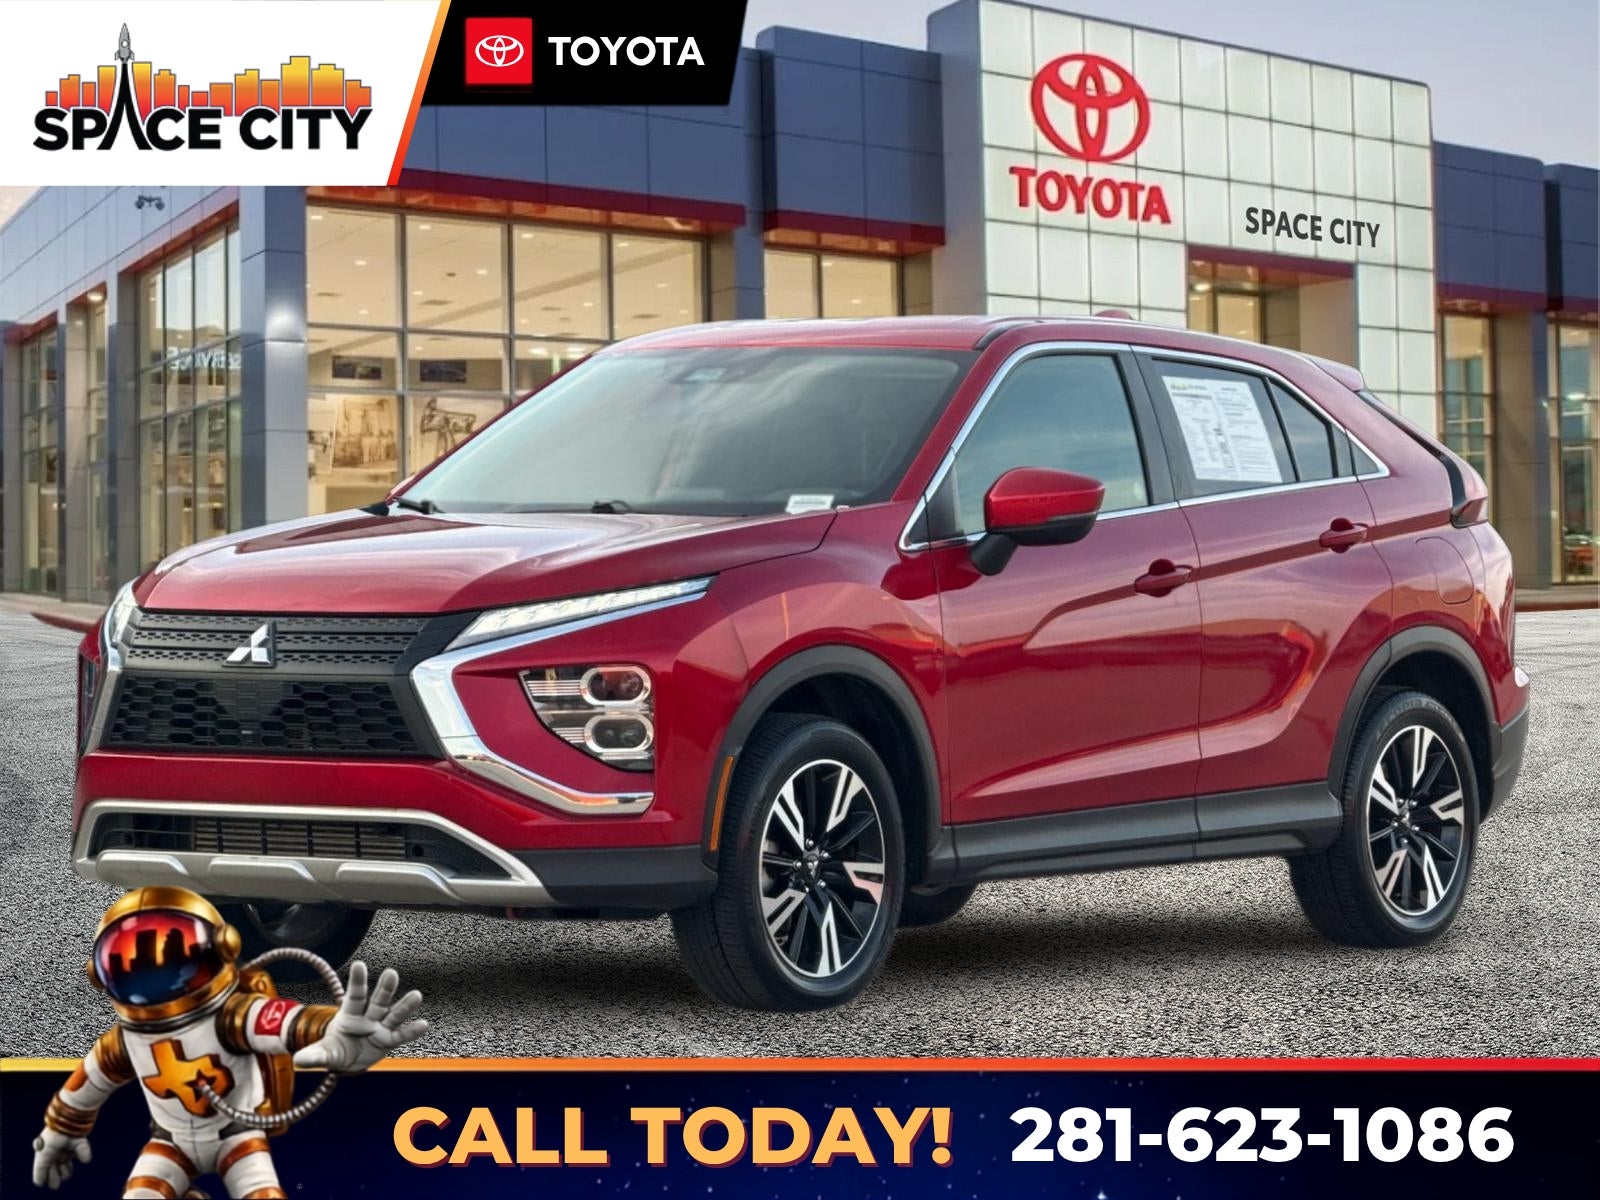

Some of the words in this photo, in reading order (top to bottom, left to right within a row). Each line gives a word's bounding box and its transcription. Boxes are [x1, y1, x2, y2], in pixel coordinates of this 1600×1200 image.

[1009, 165, 1172, 225] TOYOTA
[1245, 206, 1323, 242] SPACE
[1329, 216, 1381, 249] CITY
